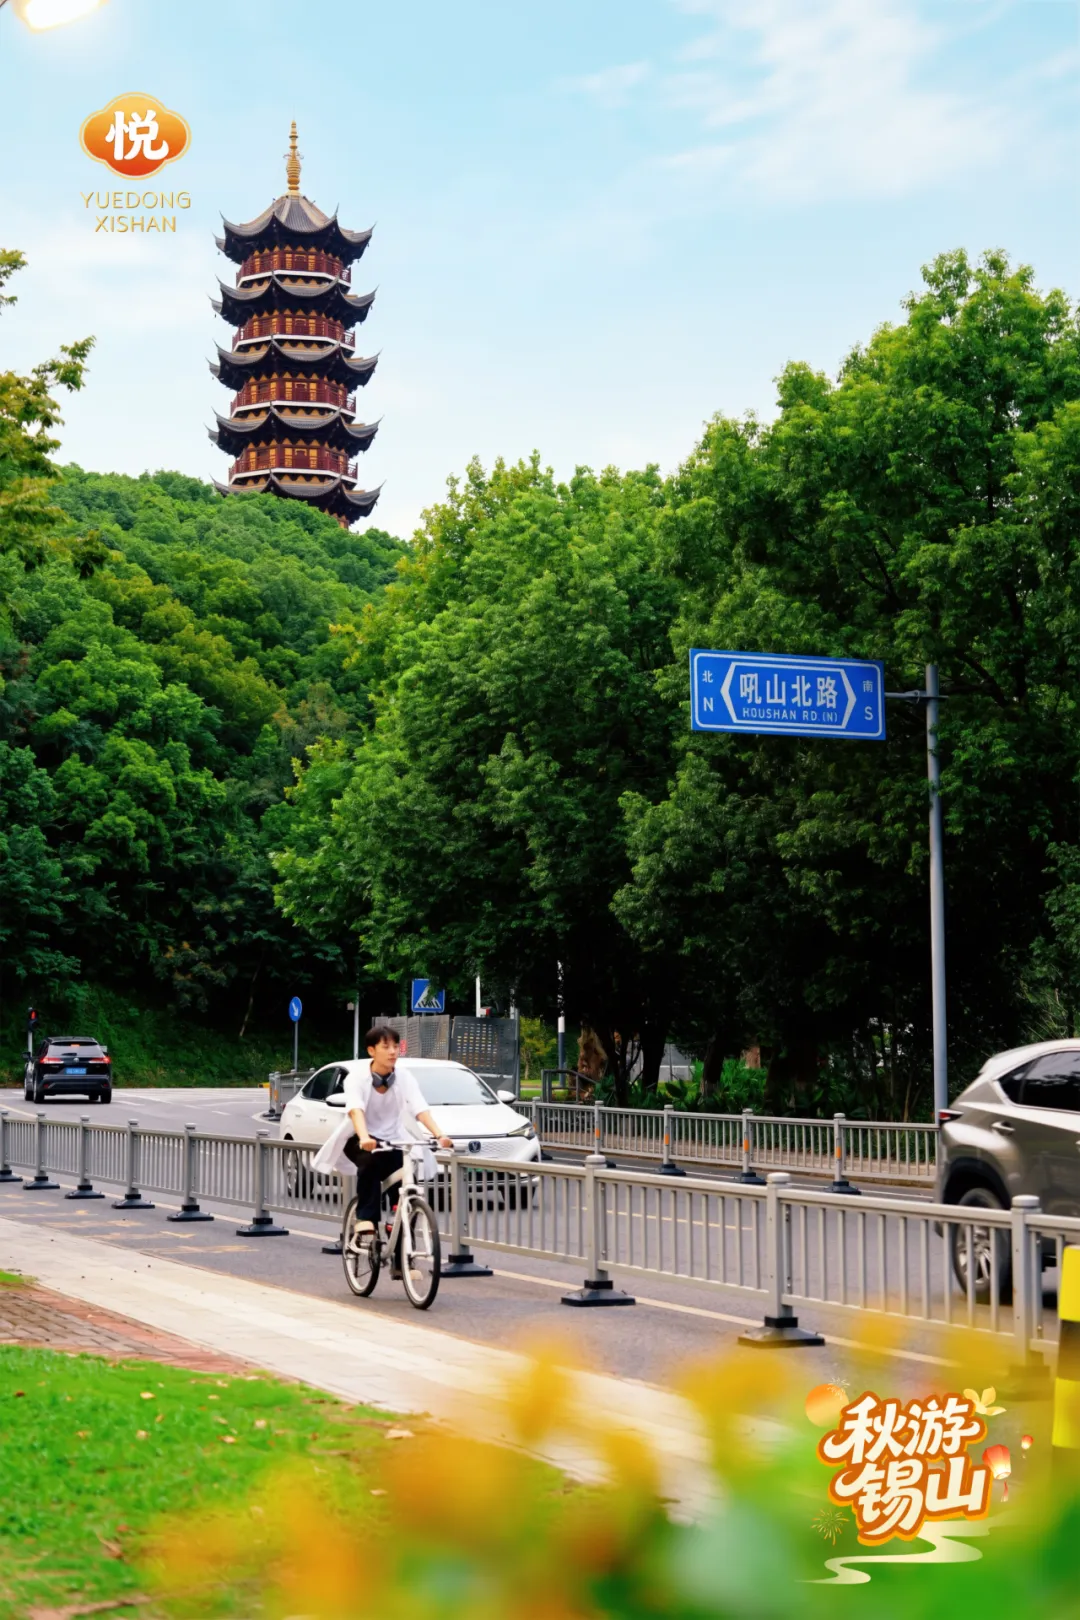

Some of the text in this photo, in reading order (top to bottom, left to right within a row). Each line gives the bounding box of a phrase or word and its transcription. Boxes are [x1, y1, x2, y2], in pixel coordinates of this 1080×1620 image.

[702, 670, 713, 683] 北
[739, 672, 838, 709] 吼山北路
[862, 680, 873, 693] 南
[703, 697, 714, 712] N
[742, 707, 797, 720] HOUSHAN
[864, 706, 874, 721] S
